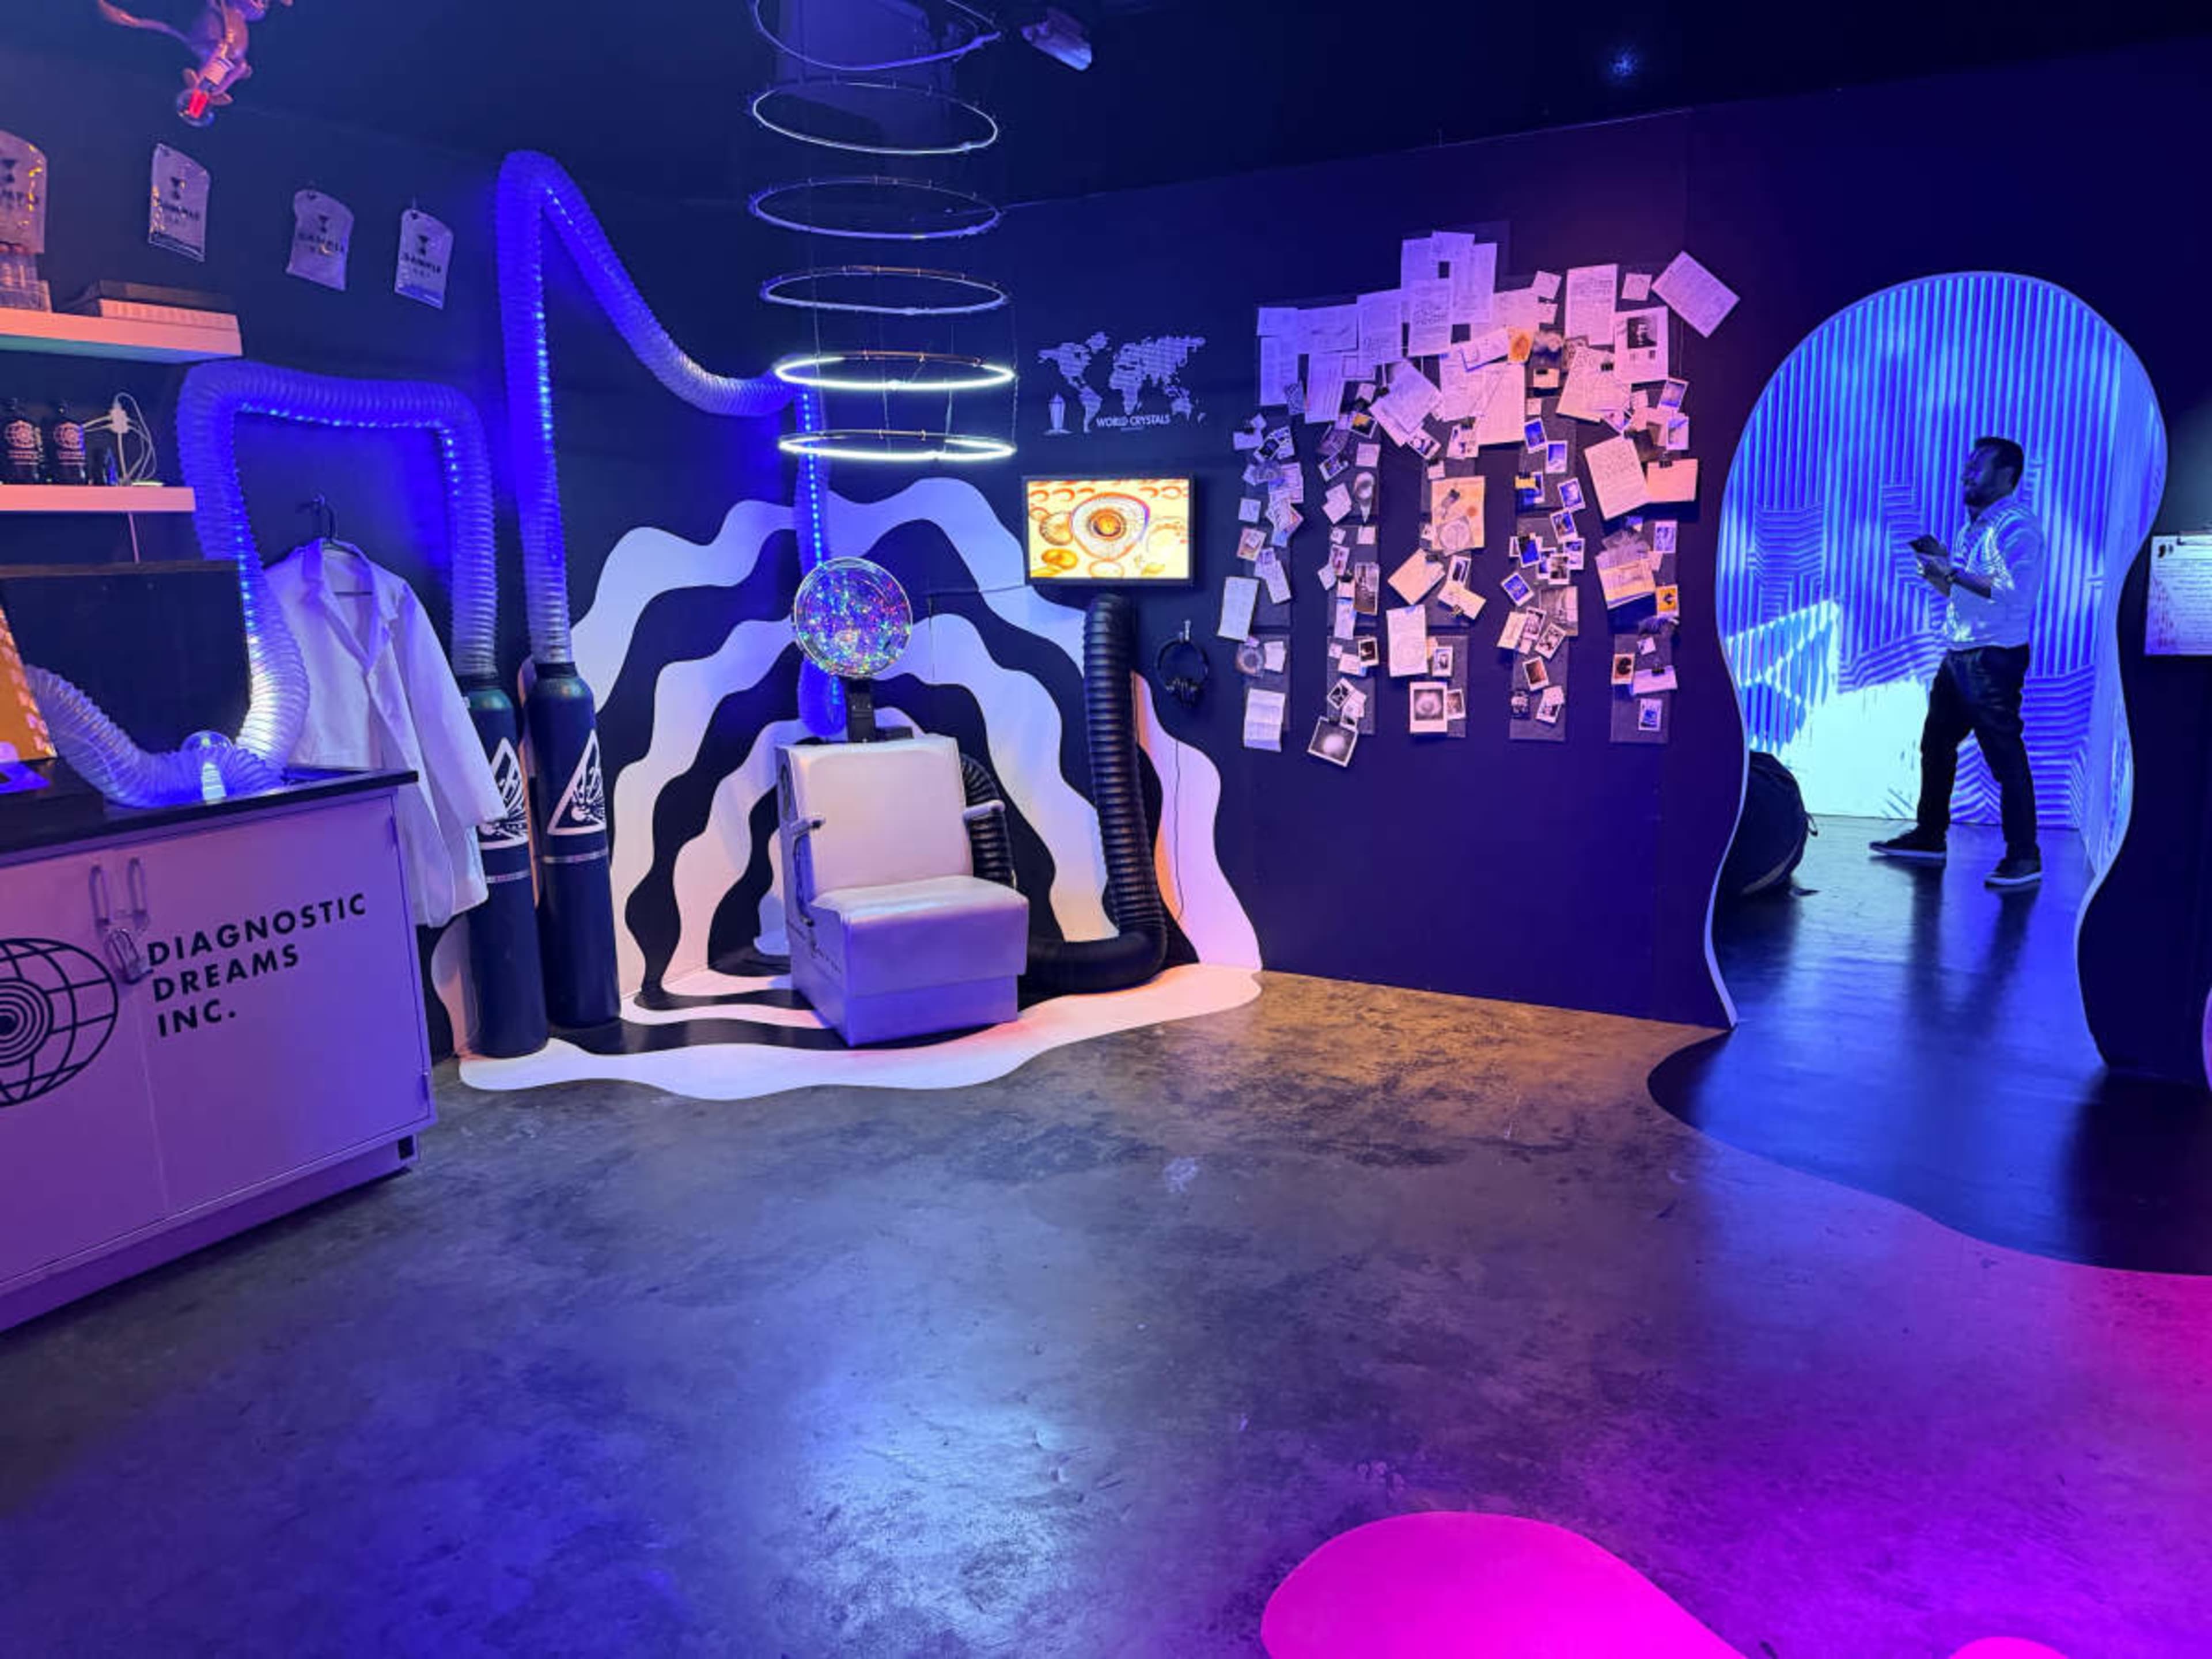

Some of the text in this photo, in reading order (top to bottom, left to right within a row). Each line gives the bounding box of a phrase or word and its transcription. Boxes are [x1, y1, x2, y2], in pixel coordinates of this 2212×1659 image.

[1096, 414, 1171, 427] WORLD CRYSTALS
[147, 892, 365, 967] DIAGNOSTIC
[153, 943, 298, 1003] DREAMS
[157, 999, 236, 1037] INC.
